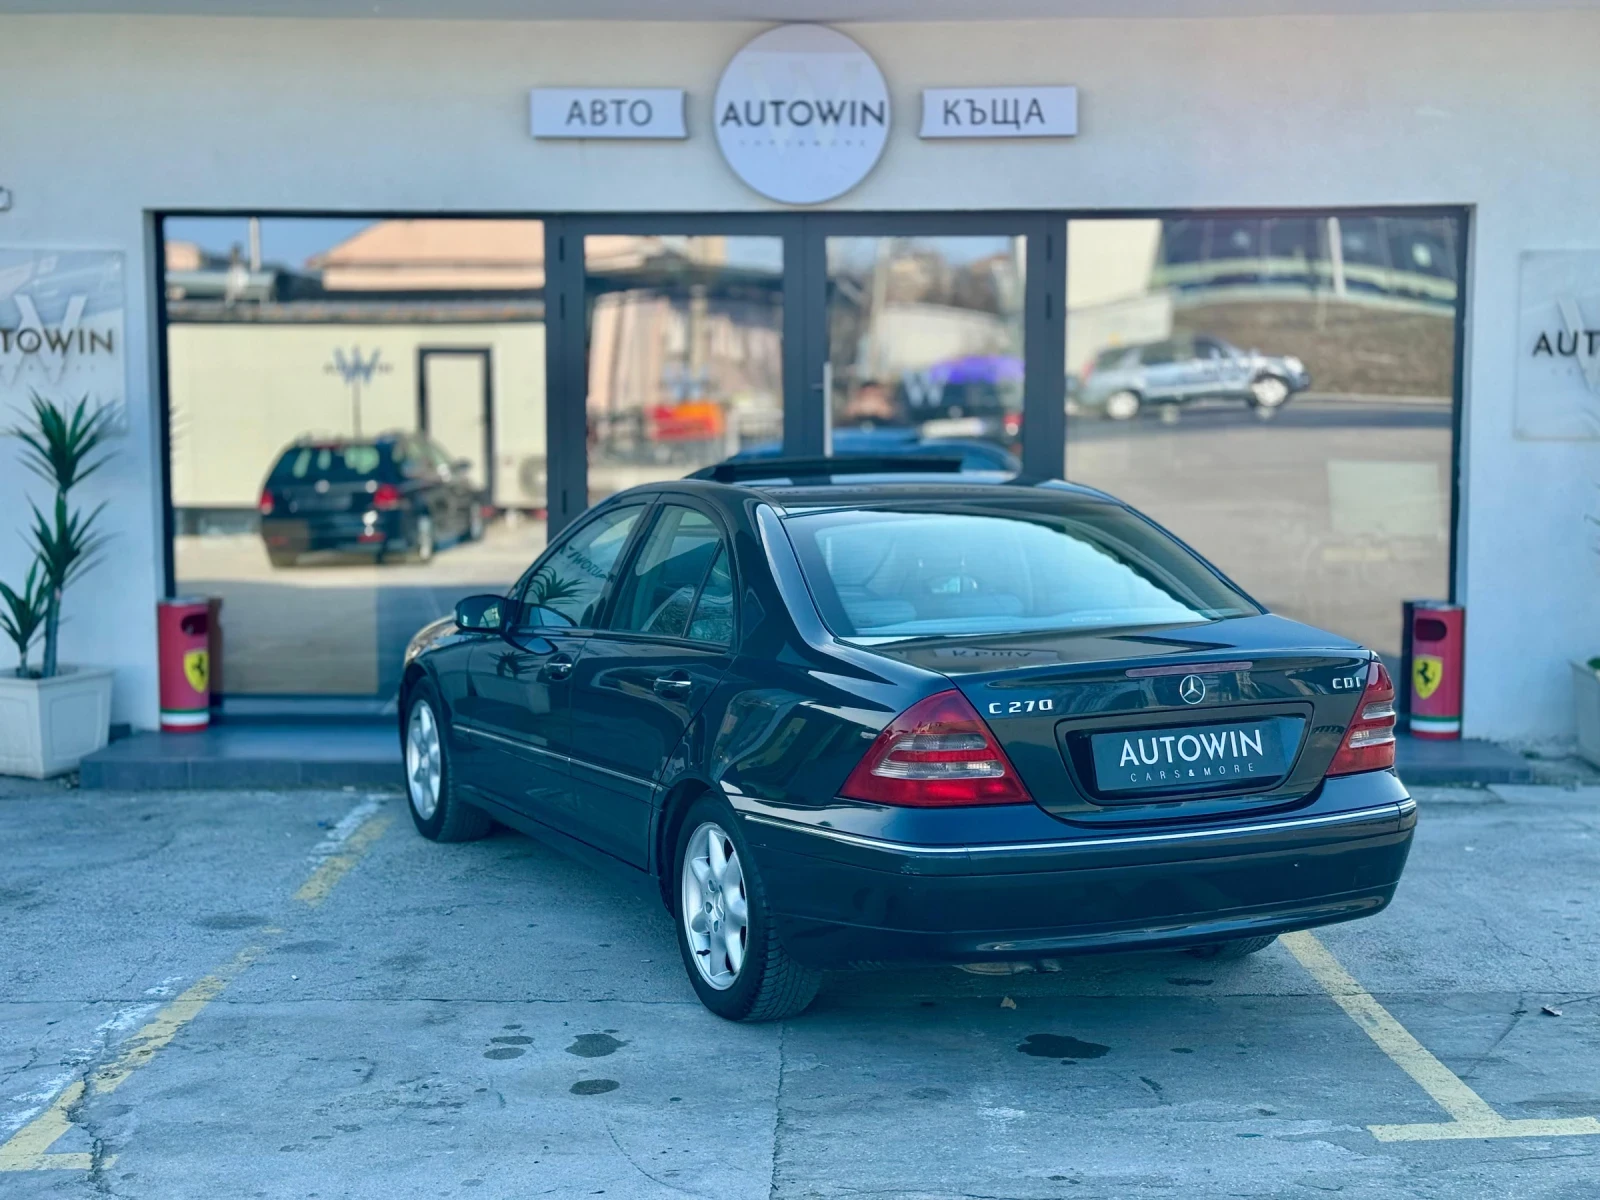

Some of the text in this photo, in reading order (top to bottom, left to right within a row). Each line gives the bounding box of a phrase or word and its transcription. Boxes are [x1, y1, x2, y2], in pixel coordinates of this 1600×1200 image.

[565, 99, 653, 127] АВТО
[720, 100, 885, 127] AUTOWIN
[943, 97, 1045, 130] КЪЩА
[1332, 676, 1361, 689] CDI
[988, 699, 1053, 714] C 270
[1119, 729, 1264, 768] AUTOWIN
